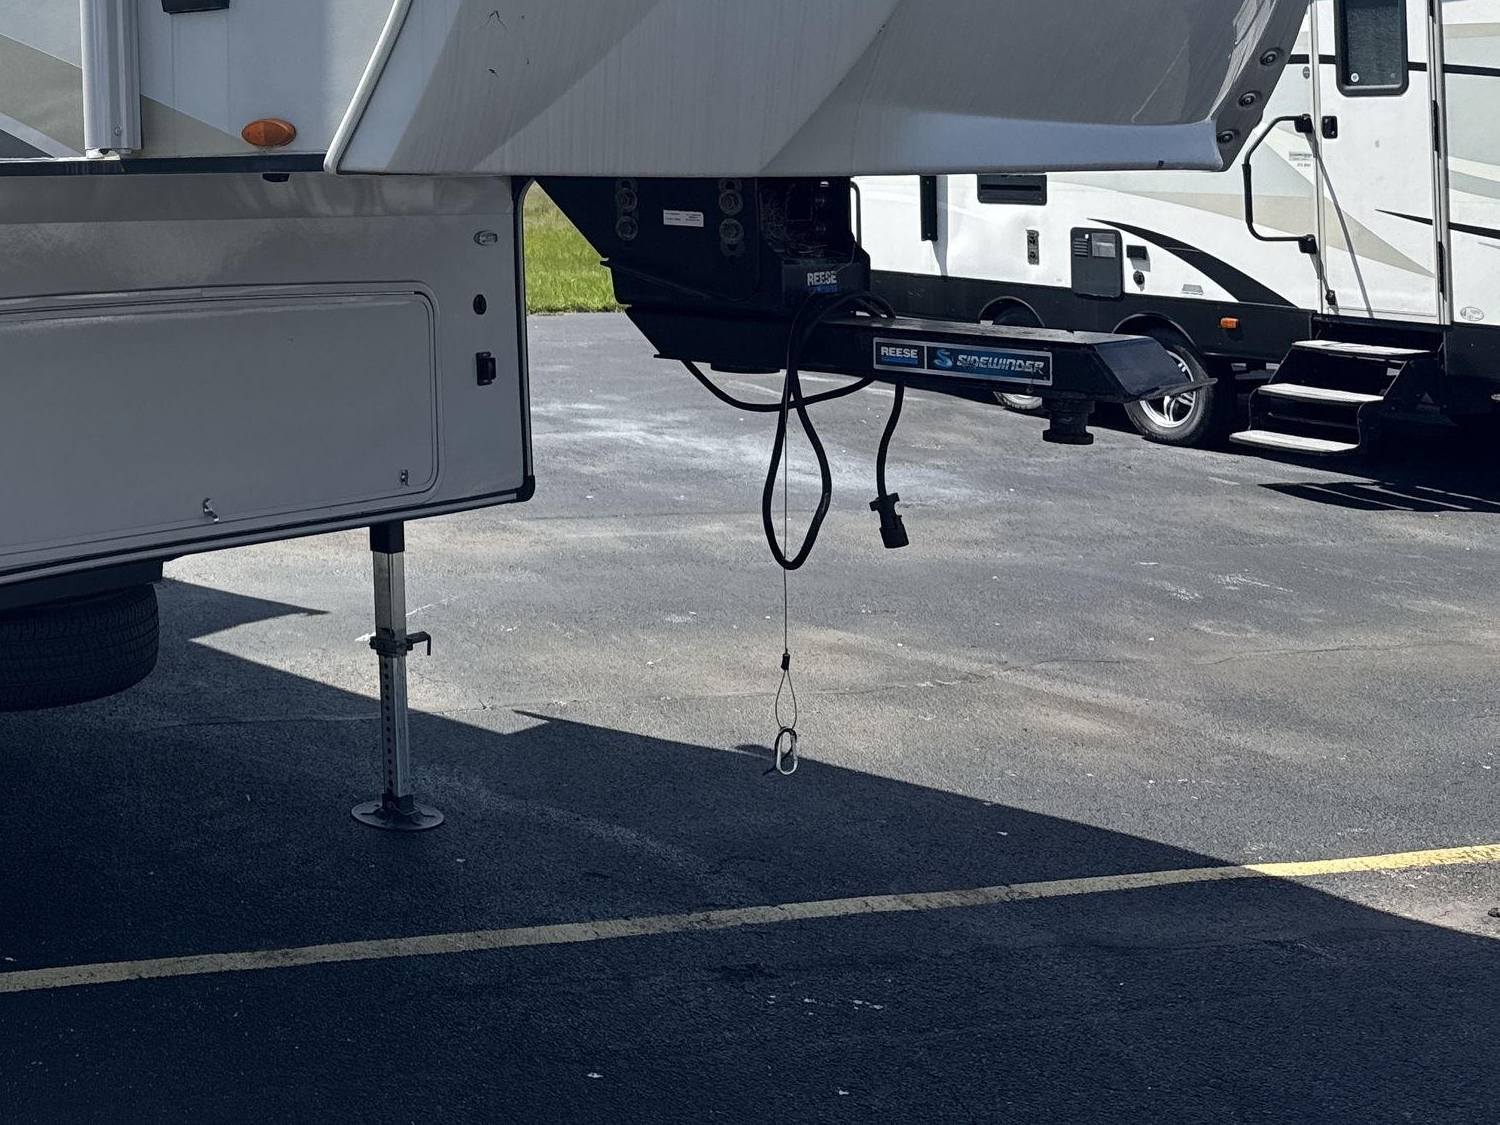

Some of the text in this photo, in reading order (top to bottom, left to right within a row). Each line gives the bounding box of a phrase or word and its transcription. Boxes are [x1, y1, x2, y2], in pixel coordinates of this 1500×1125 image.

[806, 270, 837, 286] REESE
[880, 346, 1045, 375] REESE SIDEWINDER
